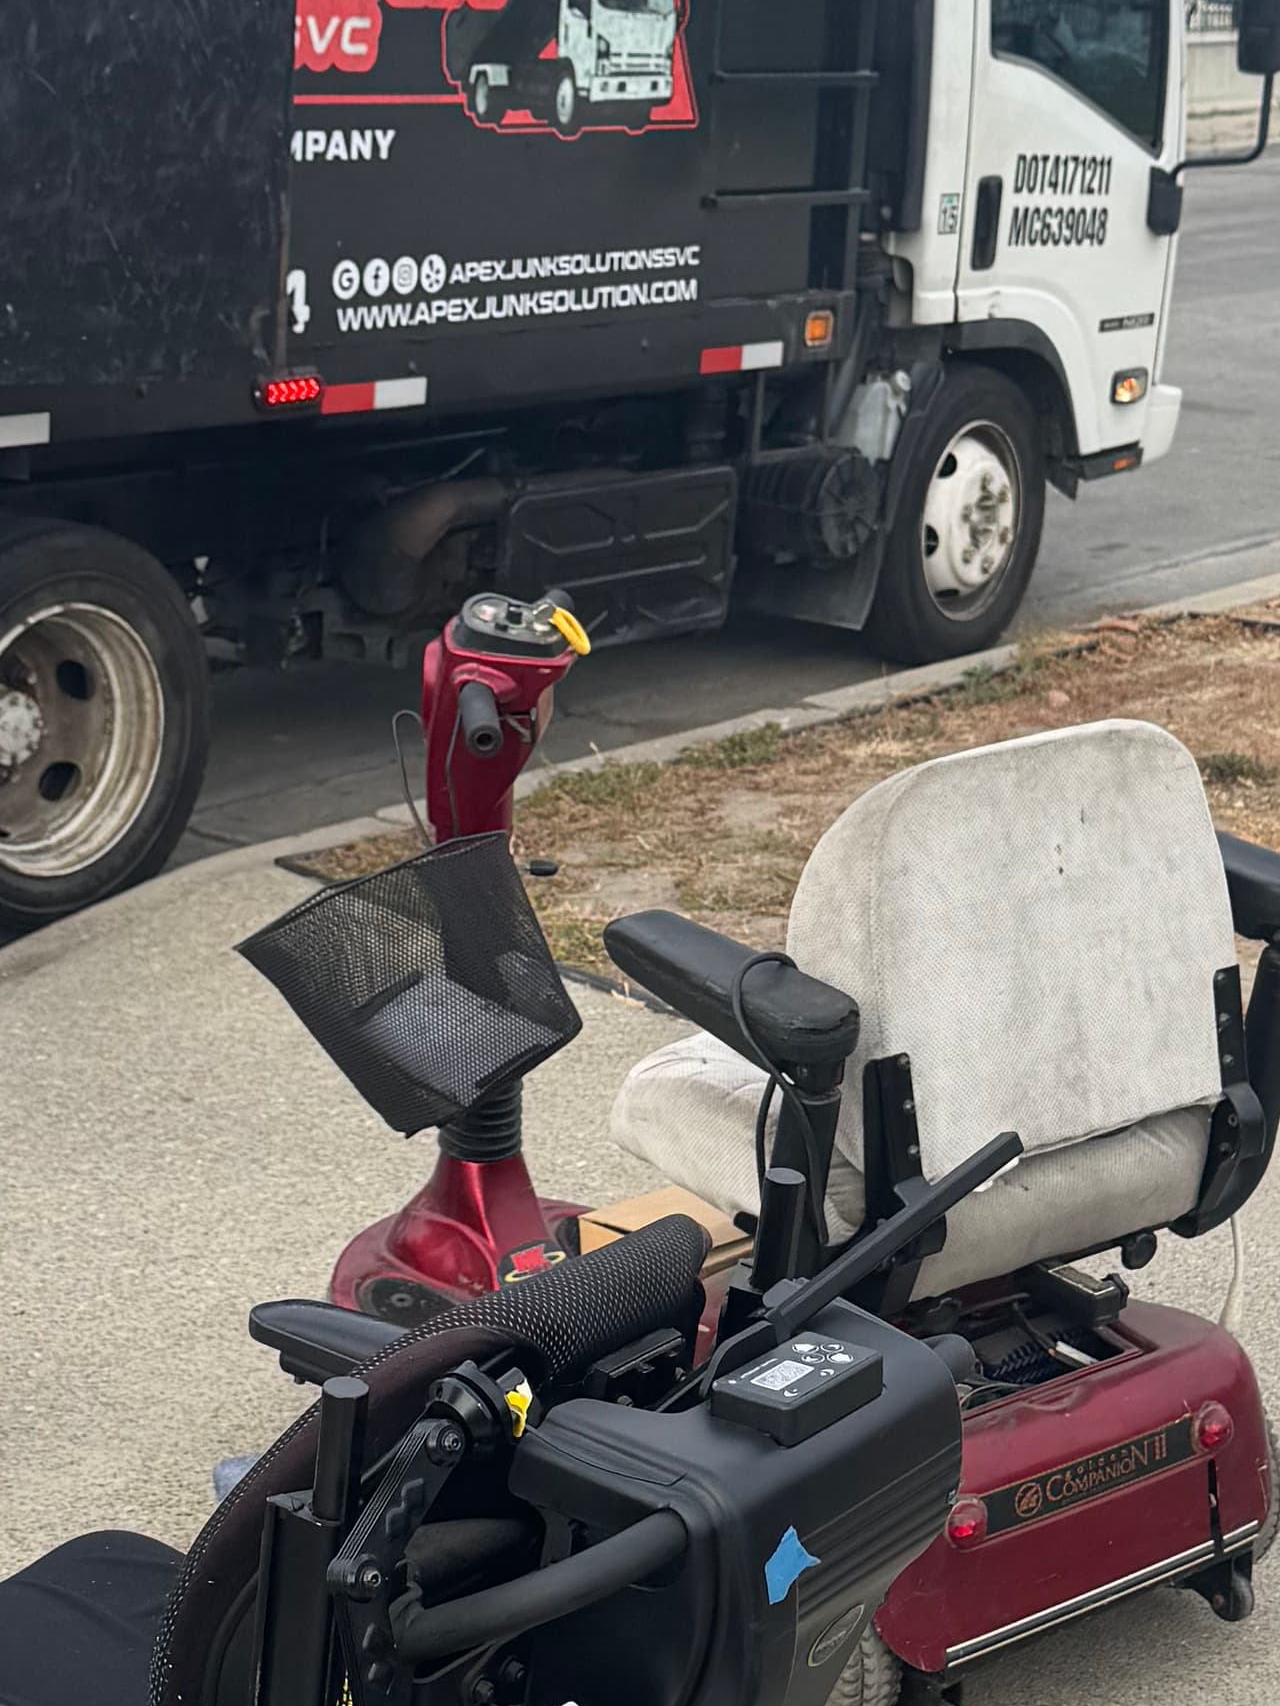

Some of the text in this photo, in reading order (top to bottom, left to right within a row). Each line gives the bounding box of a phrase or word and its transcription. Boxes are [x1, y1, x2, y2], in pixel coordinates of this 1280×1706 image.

[1013, 153, 1113, 195] DOT4171211
[1008, 206, 1109, 247] MC639048
[448, 245, 701, 285] APEXJUNKSOLUTIONSSVC
[336, 278, 699, 333] WWW.APEXJUNKSOLUTION.COM
